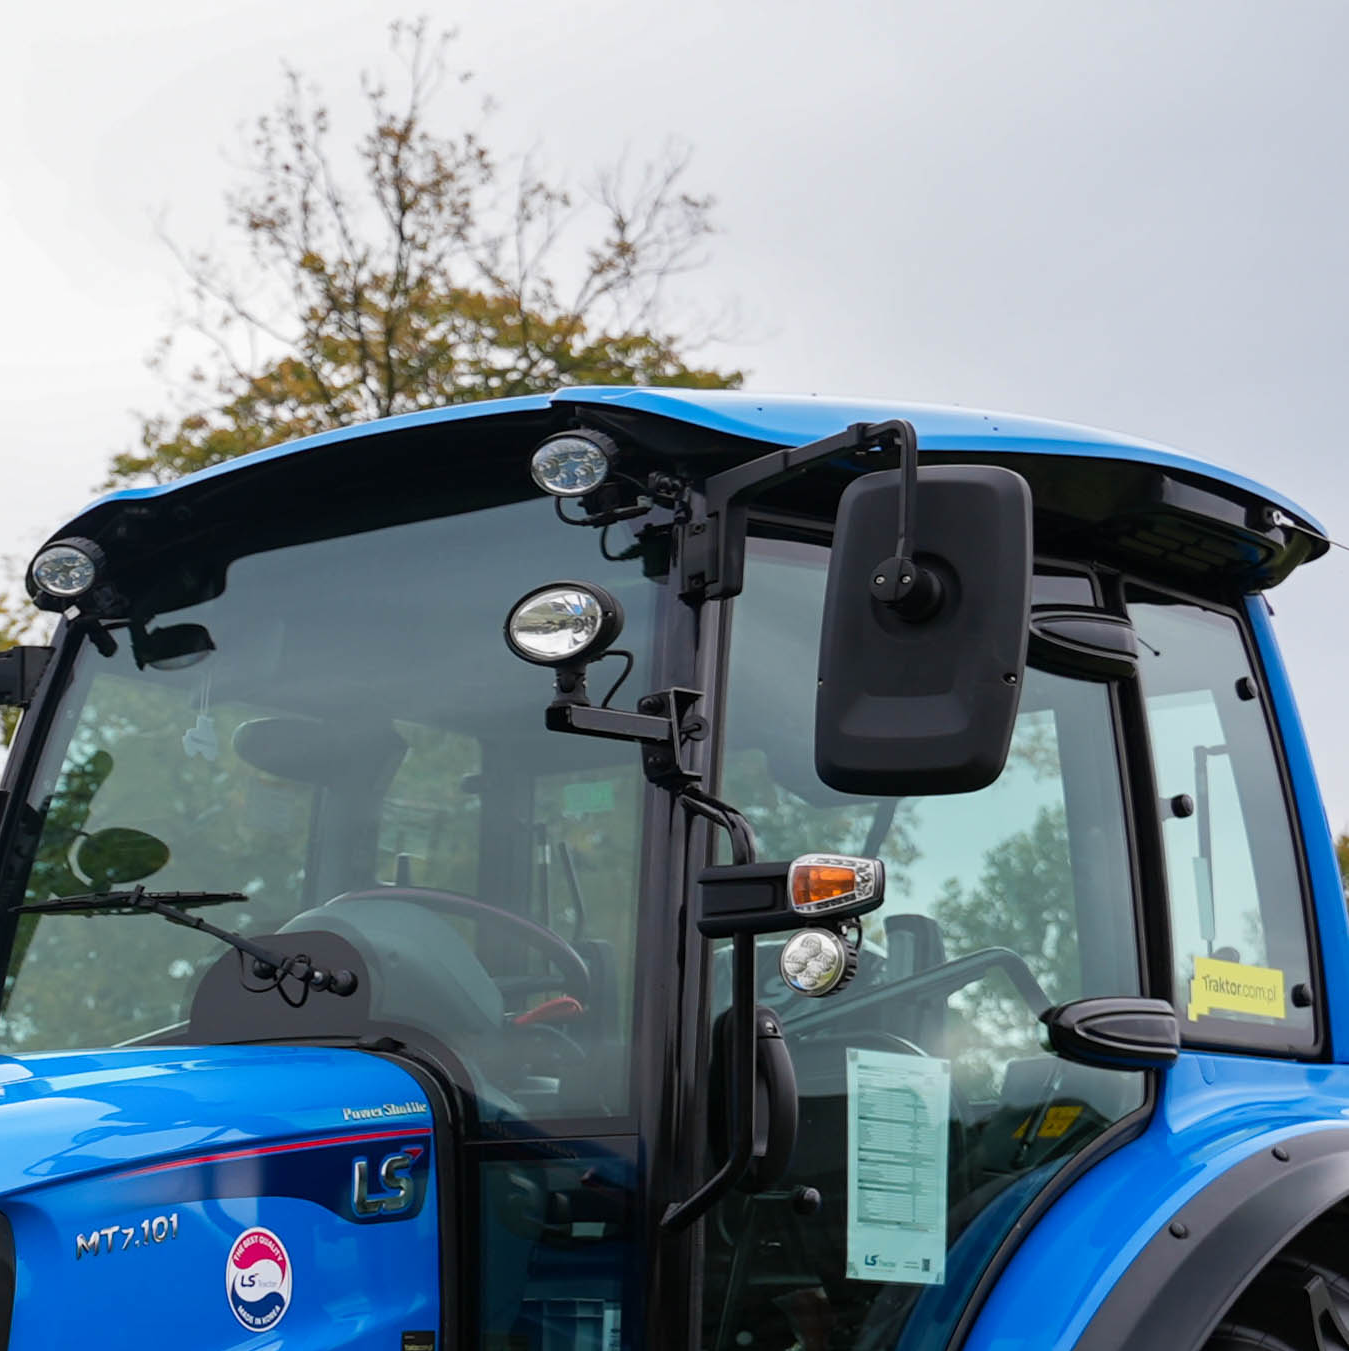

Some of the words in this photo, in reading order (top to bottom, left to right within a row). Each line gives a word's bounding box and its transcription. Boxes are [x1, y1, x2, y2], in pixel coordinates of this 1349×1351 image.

[1201, 974, 1277, 1004] Traktor.com.pl
[353, 1155, 414, 1214] LS
[76, 1213, 178, 1260] MT7.101
[259, 1235, 283, 1262] QUALITY
[240, 1274, 256, 1288] LS
